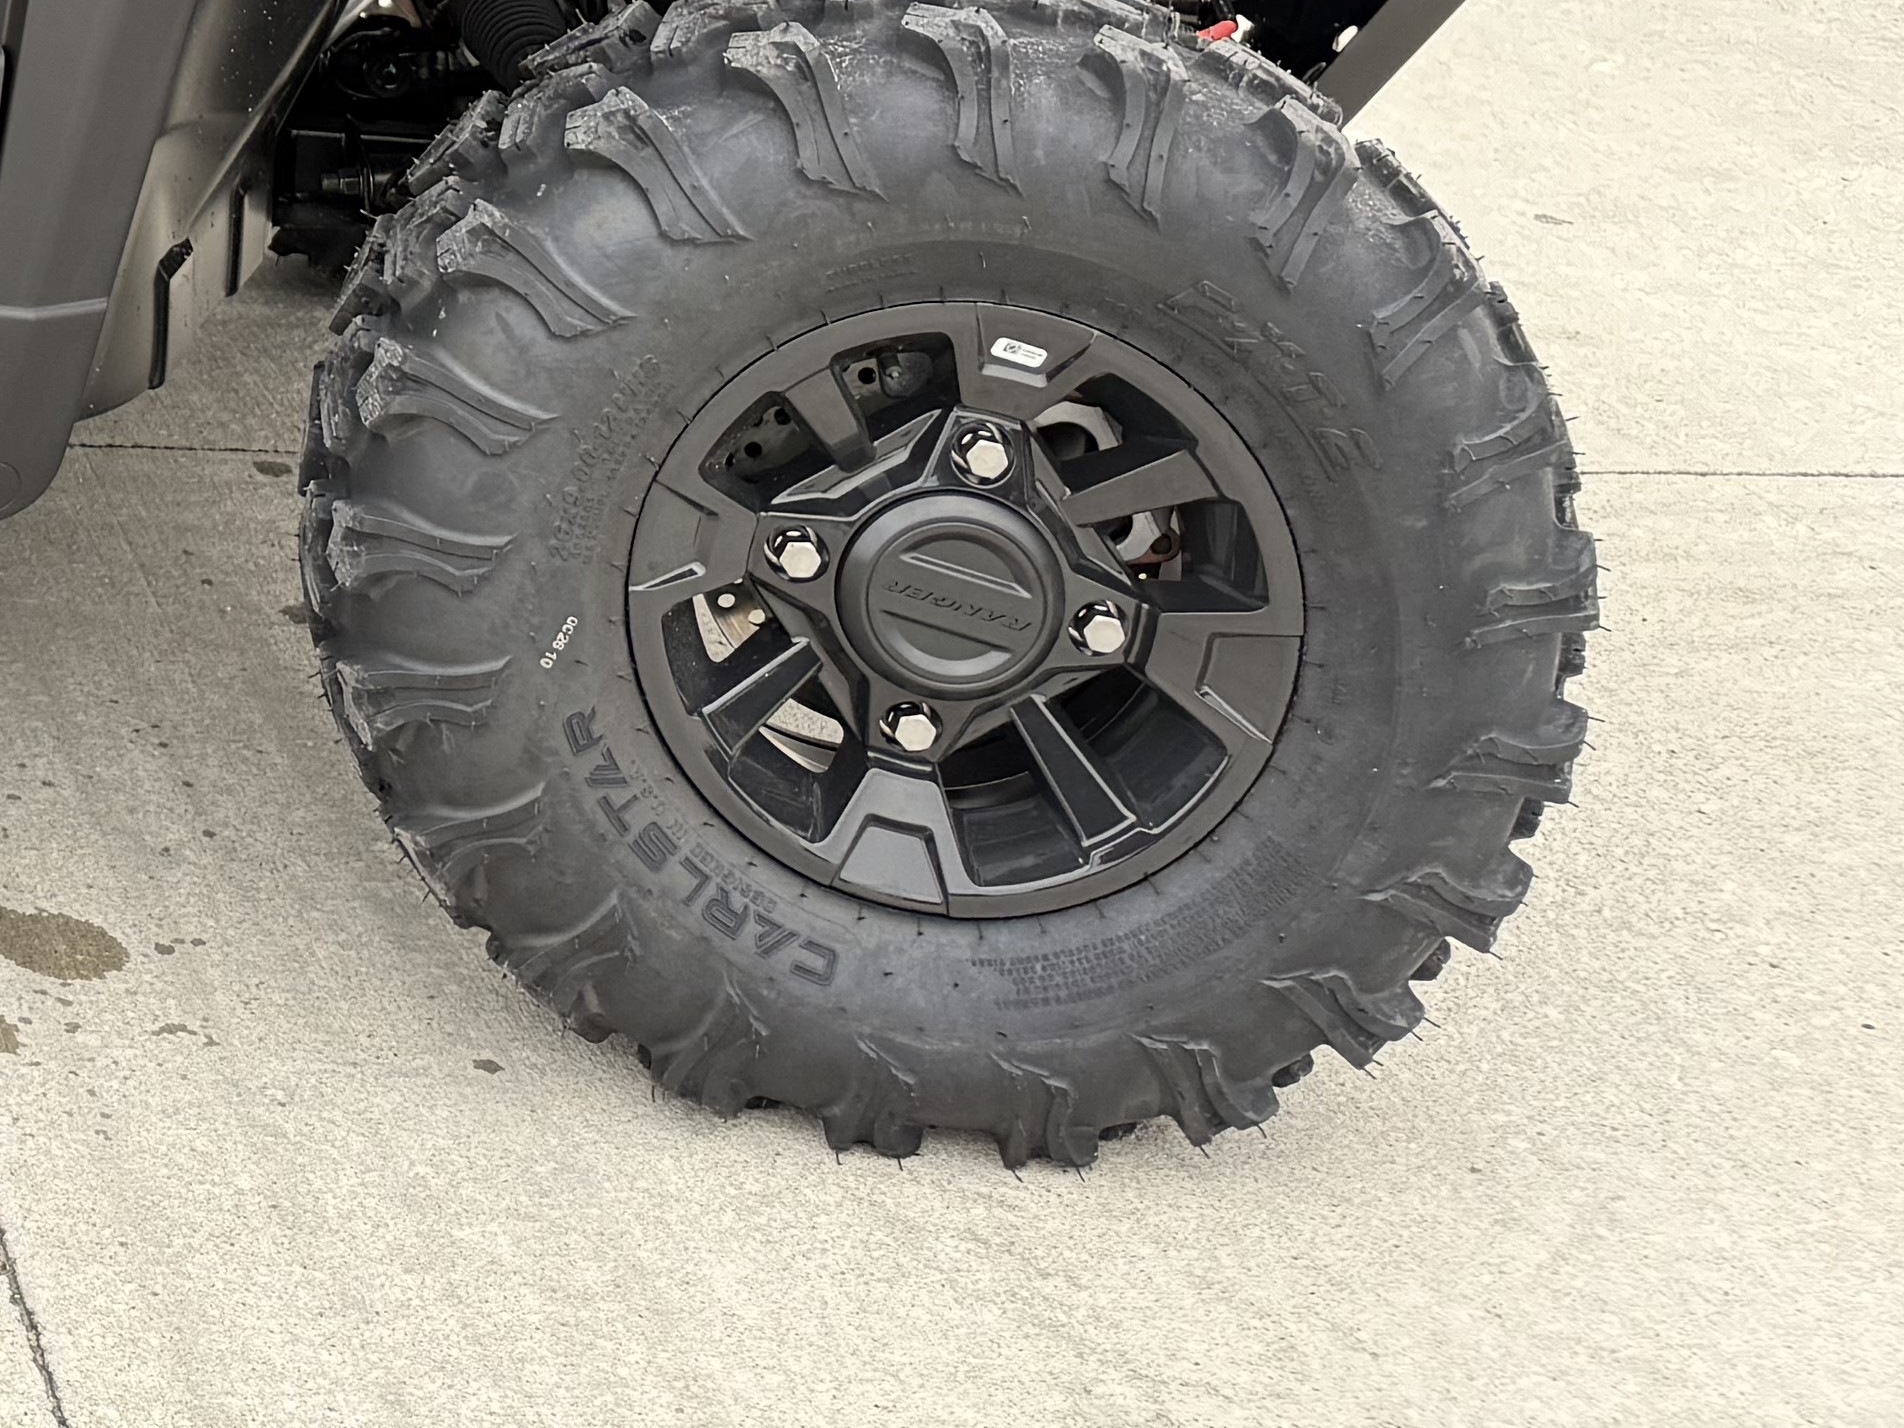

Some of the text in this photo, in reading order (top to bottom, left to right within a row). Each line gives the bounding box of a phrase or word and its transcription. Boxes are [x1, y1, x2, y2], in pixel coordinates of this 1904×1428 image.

[886, 580, 1033, 632] RANGER
[539, 651, 558, 669] 10
[562, 704, 840, 988] CARLSTAR
